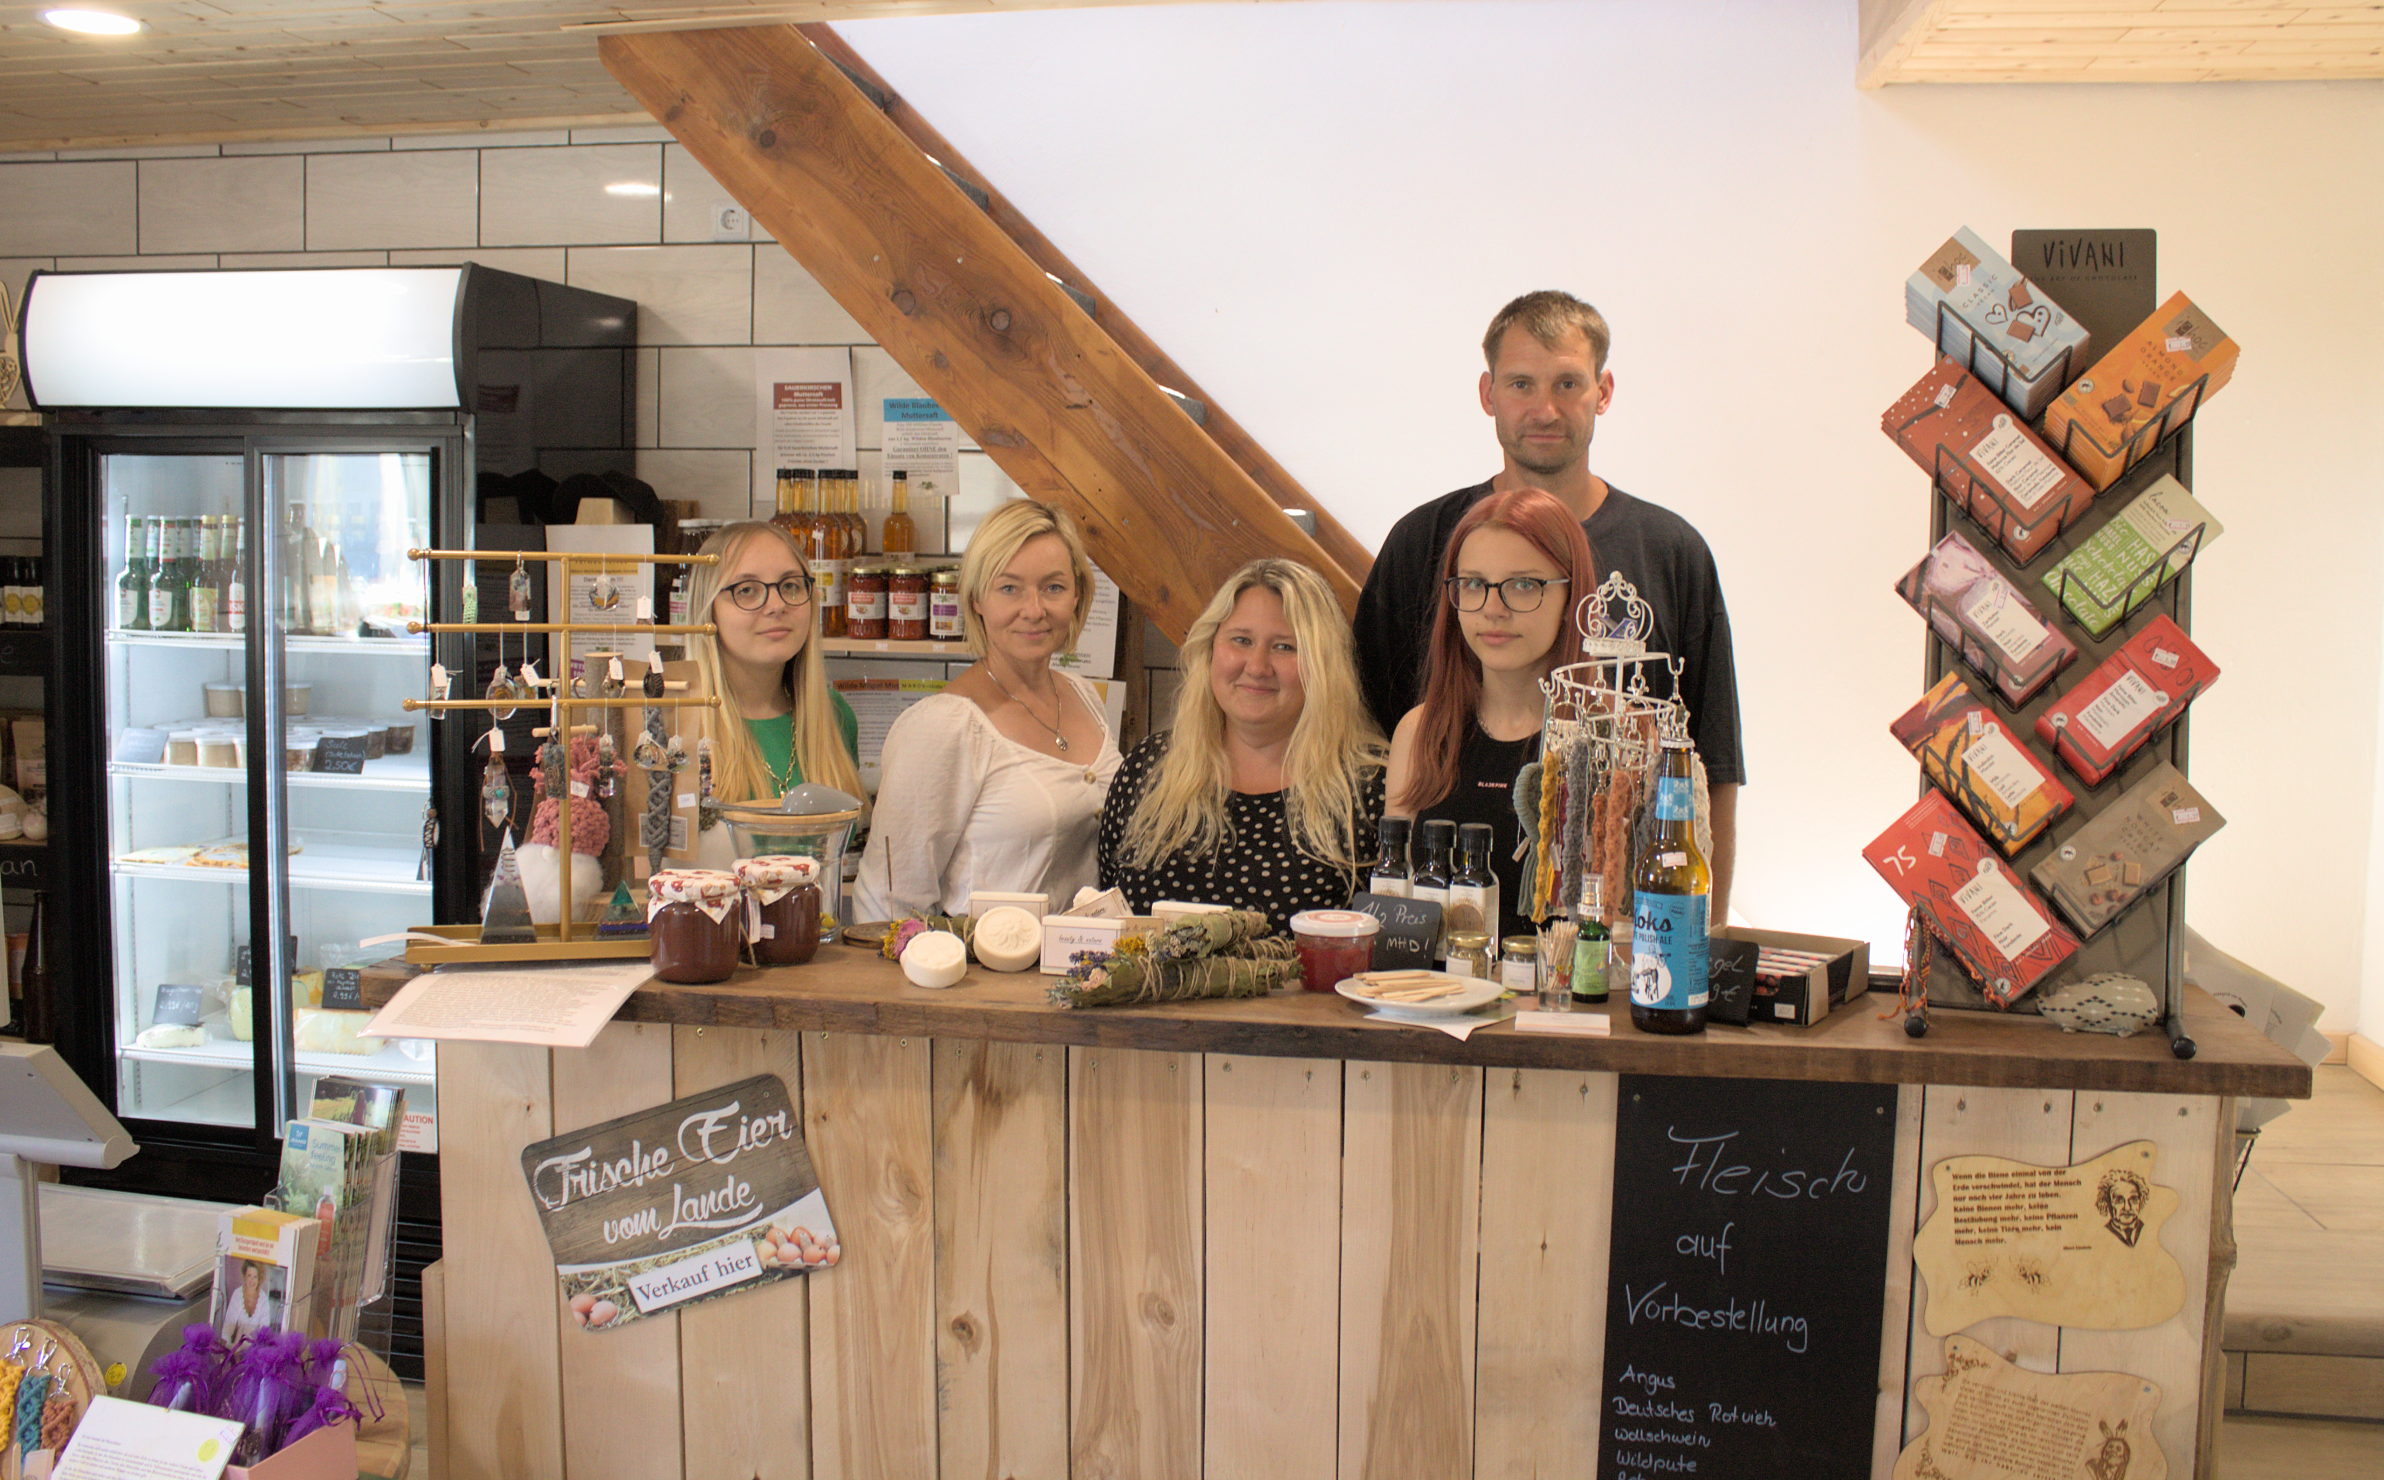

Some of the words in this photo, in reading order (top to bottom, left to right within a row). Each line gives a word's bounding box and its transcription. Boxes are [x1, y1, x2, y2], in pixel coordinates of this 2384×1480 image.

[1959, 273, 1999, 309] CLASSIC
[2138, 346, 2176, 382] ORANGE
[2145, 339, 2184, 376] ALMOND
[2094, 529, 2116, 552] NUSS
[2100, 523, 2122, 545] HASEL
[2125, 536, 2169, 580] HASL
[2119, 825, 2150, 854] CRISP
[2121, 815, 2163, 852] NOUGAT
[2133, 812, 2166, 843] WHITE
[1883, 845, 1916, 876] 75
[1394, 904, 1427, 925] Preis
[1638, 932, 1657, 943] POLISH
[1659, 935, 1672, 944] ALE
[403, 1114, 433, 1124] AUTION
[533, 1139, 674, 1212] Frische
[678, 1101, 793, 1164] Eier
[1668, 1126, 1867, 1199] Fleisch
[603, 1206, 662, 1245] vom
[658, 1175, 763, 1240] Lande
[1954, 1216, 1997, 1224] Bestäubung
[1676, 1222, 1735, 1276] auf
[636, 1265, 711, 1302] Verkauf
[716, 1255, 755, 1278] hier
[1625, 1282, 1808, 1353] Vorbestellung
[1620, 1364, 1676, 1395] Angus
[1612, 1396, 1695, 1423] Deutsches
[1615, 1427, 1711, 1448] Wollschwein
[1616, 1449, 1698, 1473] Wildpute
